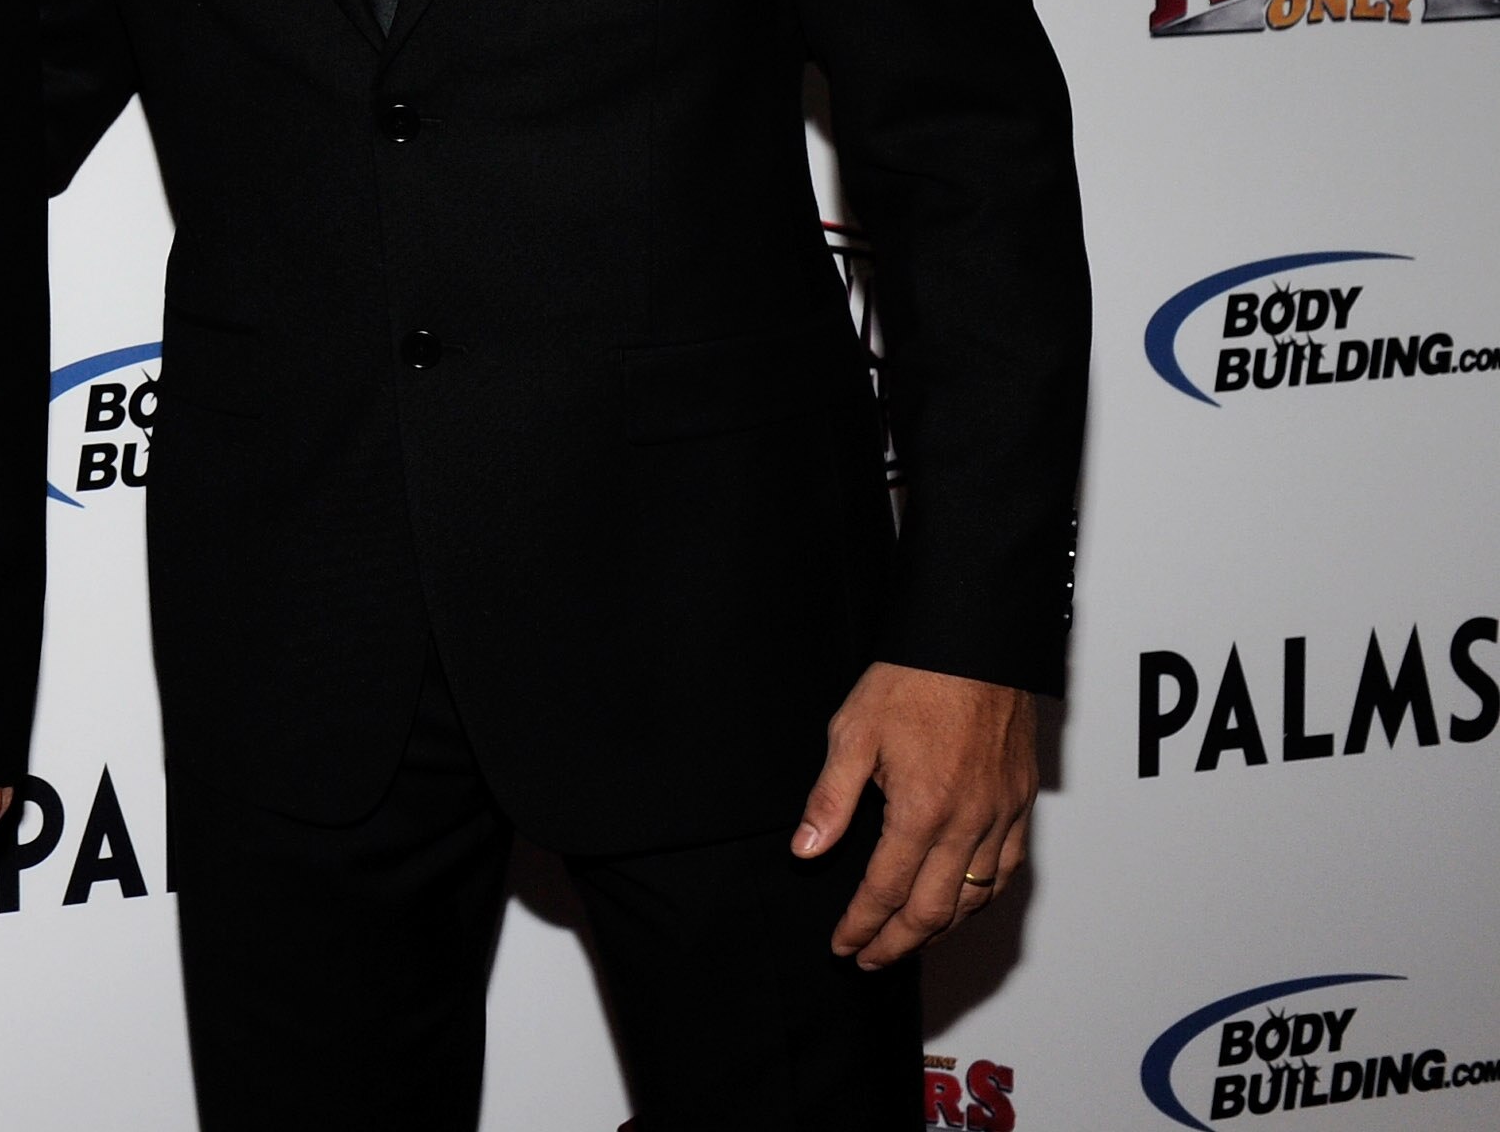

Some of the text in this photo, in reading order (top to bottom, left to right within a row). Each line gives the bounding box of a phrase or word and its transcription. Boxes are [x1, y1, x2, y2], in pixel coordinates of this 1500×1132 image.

[1222, 286, 1364, 339] BODY
[1138, 616, 1500, 779] PALMS
[1218, 1007, 1358, 1068] BODY
